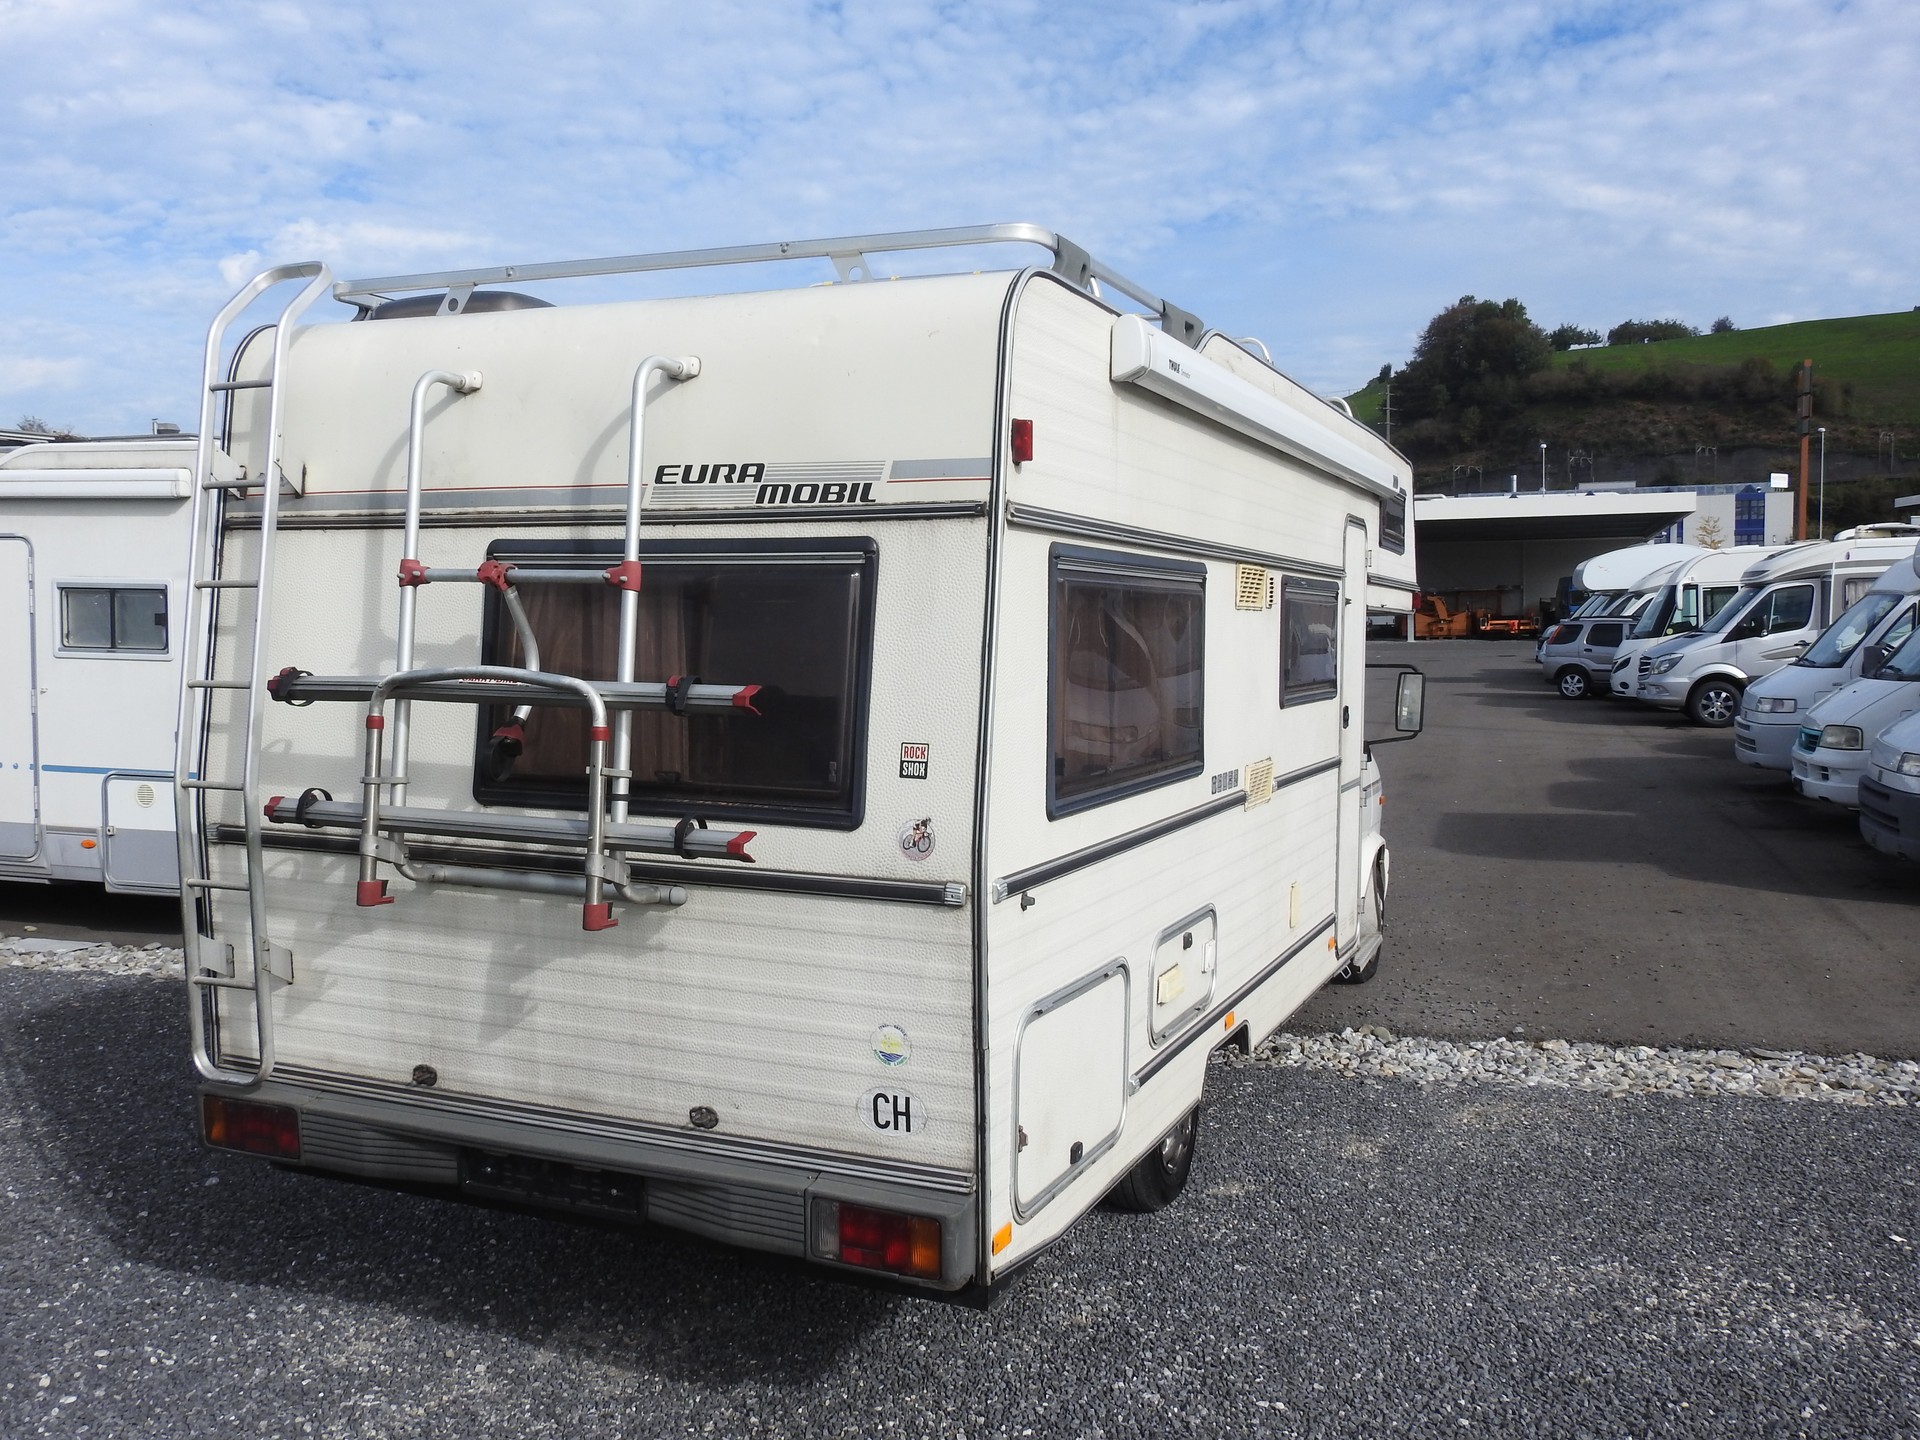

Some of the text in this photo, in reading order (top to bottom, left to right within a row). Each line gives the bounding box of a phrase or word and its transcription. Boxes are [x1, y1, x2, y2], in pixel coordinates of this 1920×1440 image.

[654, 463, 765, 484] EURA
[755, 482, 876, 504] MOBIL
[903, 746, 926, 759] ROCK
[902, 762, 926, 776] SHOX
[872, 1093, 911, 1132] CH
